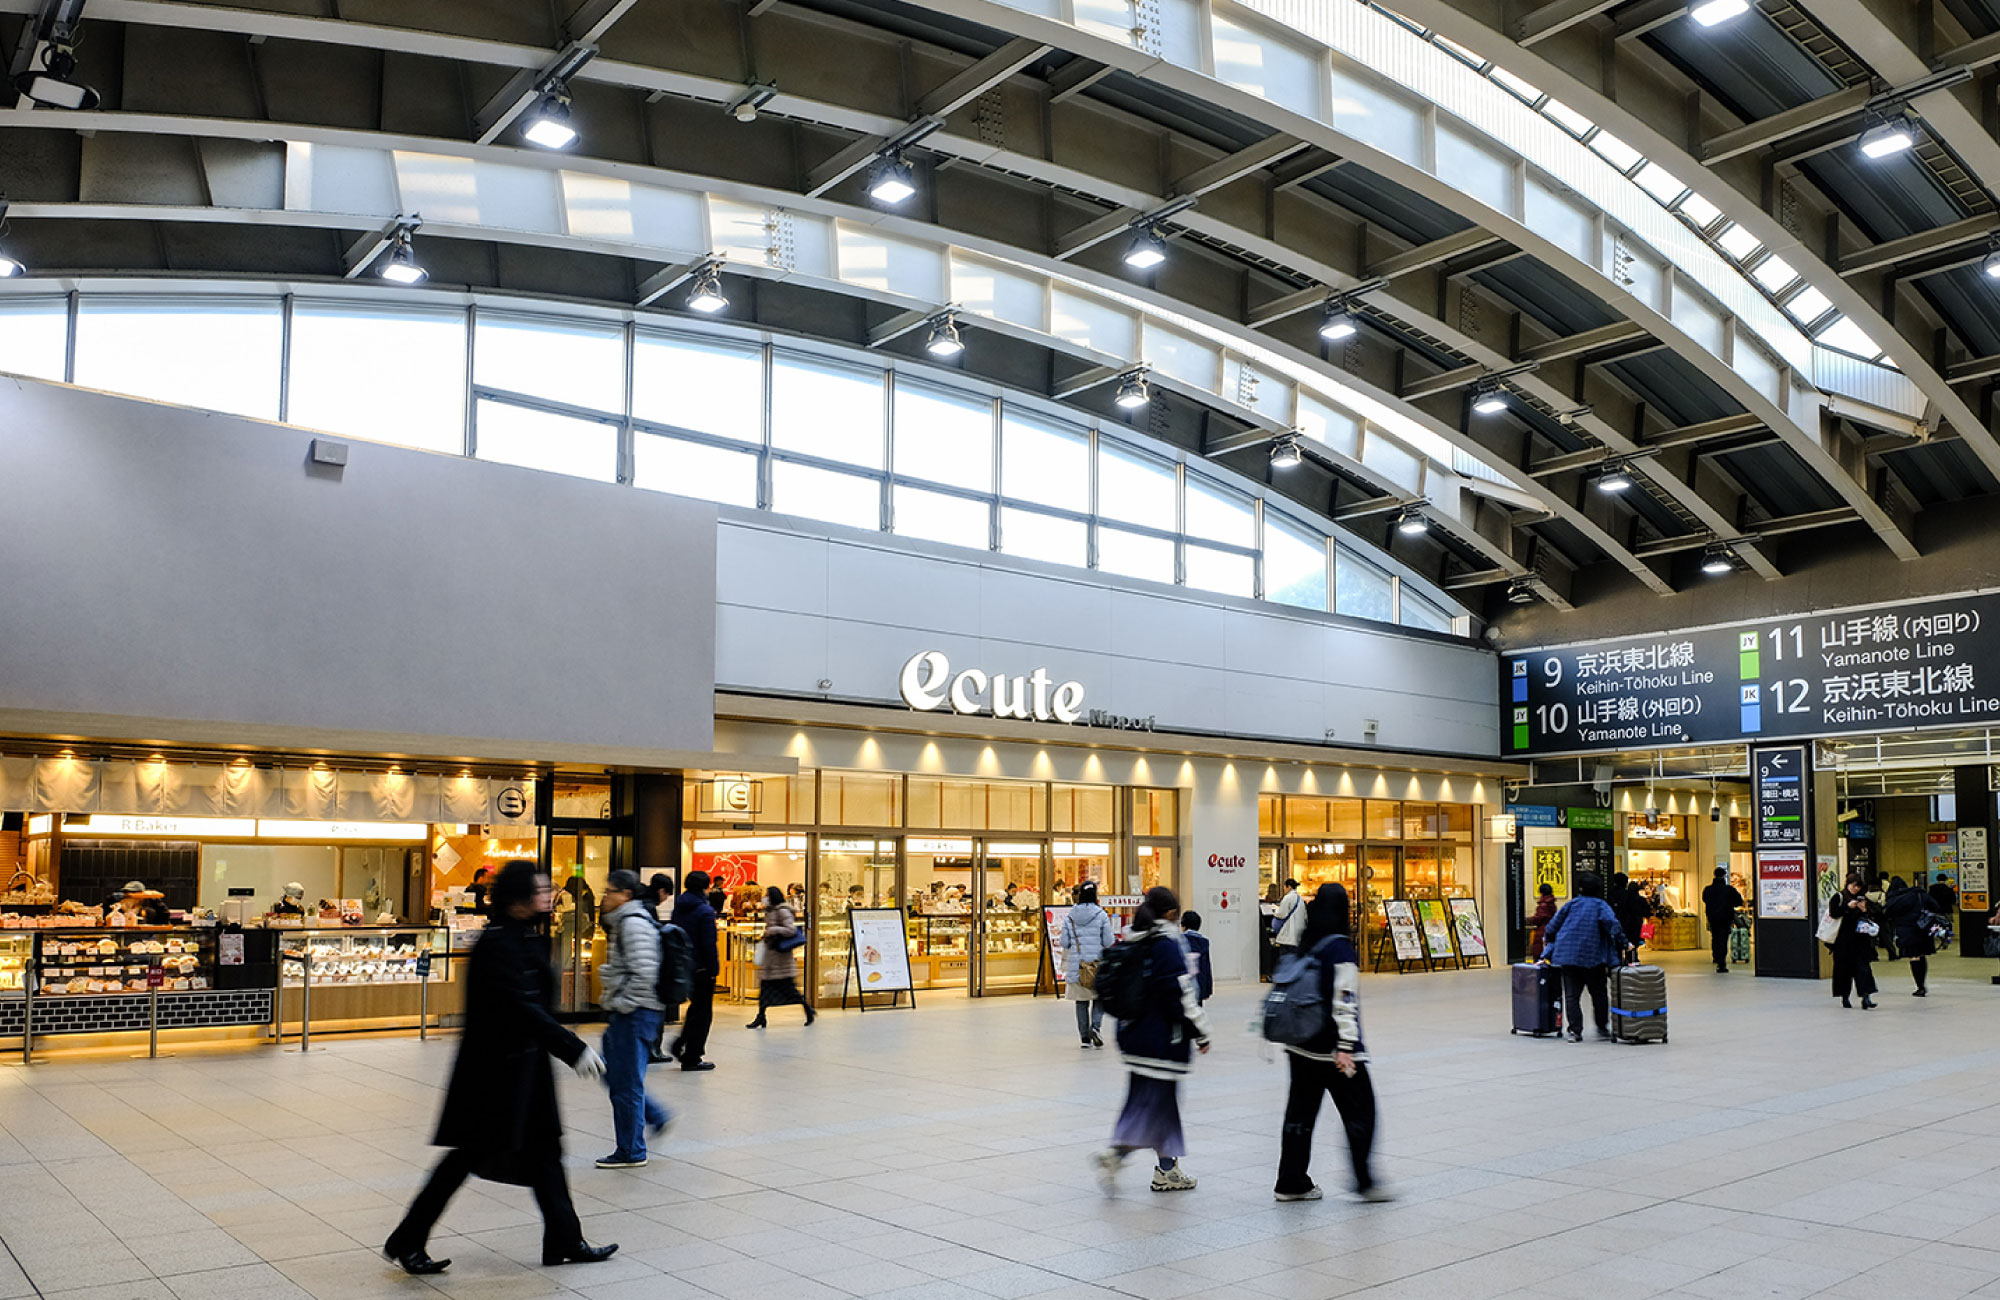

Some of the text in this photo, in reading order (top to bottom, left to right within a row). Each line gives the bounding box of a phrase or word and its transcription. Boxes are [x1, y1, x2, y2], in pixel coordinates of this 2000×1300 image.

[1742, 635, 1756, 647] JY
[1768, 624, 1804, 661] 11
[1821, 641, 1955, 668] Yamanote Line
[1514, 662, 1526, 674] JK
[1543, 657, 1563, 688] 9
[1575, 641, 1695, 679] 京浜東北線
[899, 650, 1085, 723] ecute
[1576, 669, 1714, 696] Keihin-Tōhoku Line
[1743, 688, 1757, 700] JK
[1821, 662, 1975, 705] 京浜東北線
[1769, 679, 1811, 715] 12
[1822, 696, 2000, 724] Keihin-Tōhoku Line
[1515, 709, 1526, 721] JY
[1536, 702, 1568, 734] 10
[1577, 722, 1682, 743] Yamanote Line
[1761, 765, 1770, 777] 9
[1762, 805, 1775, 816] 10
[1208, 853, 1246, 868] ecute
